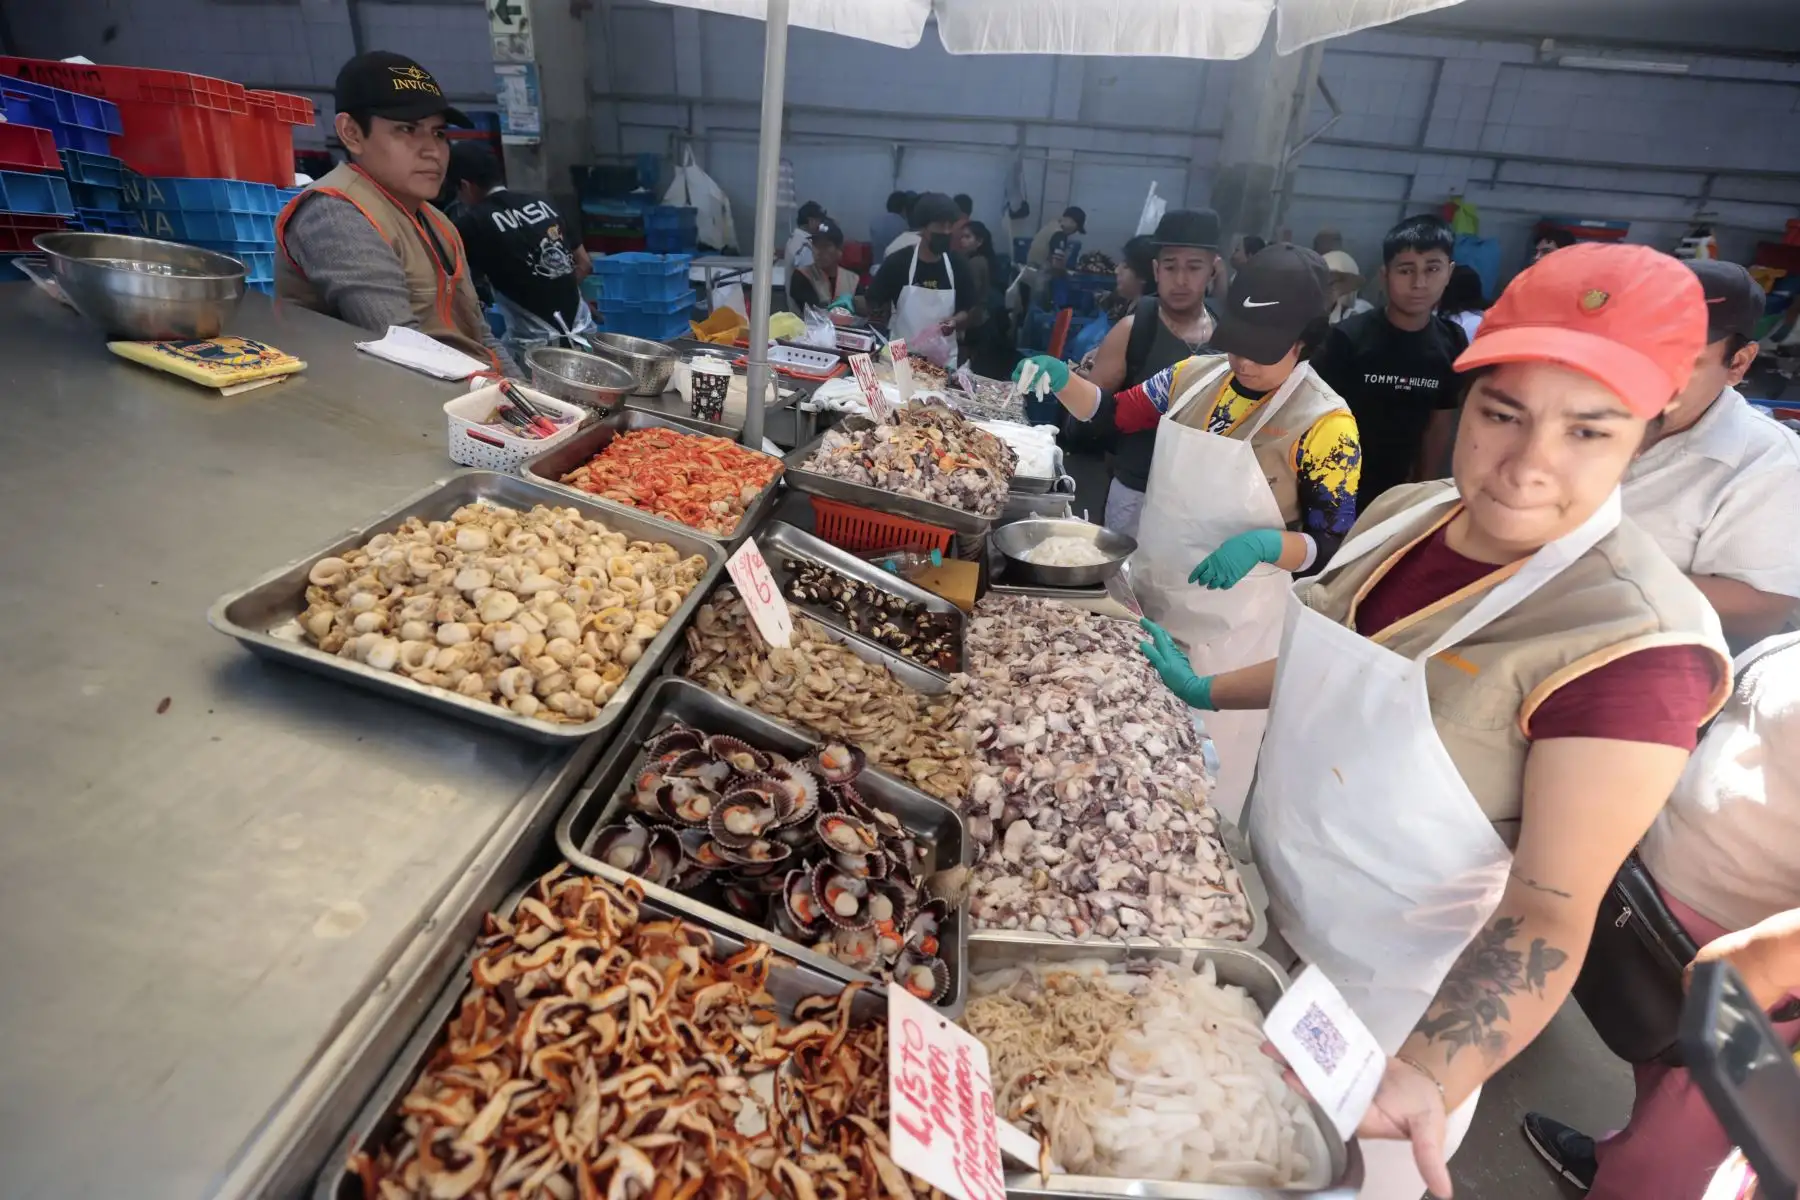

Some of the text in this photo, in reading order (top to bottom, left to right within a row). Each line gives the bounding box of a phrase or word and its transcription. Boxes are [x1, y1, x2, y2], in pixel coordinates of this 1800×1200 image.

[491, 200, 559, 232] NASA
[1363, 373, 1400, 385] TOMMY
[1408, 376, 1440, 389] HILFIGER
[928, 1044, 957, 1139] PARA
